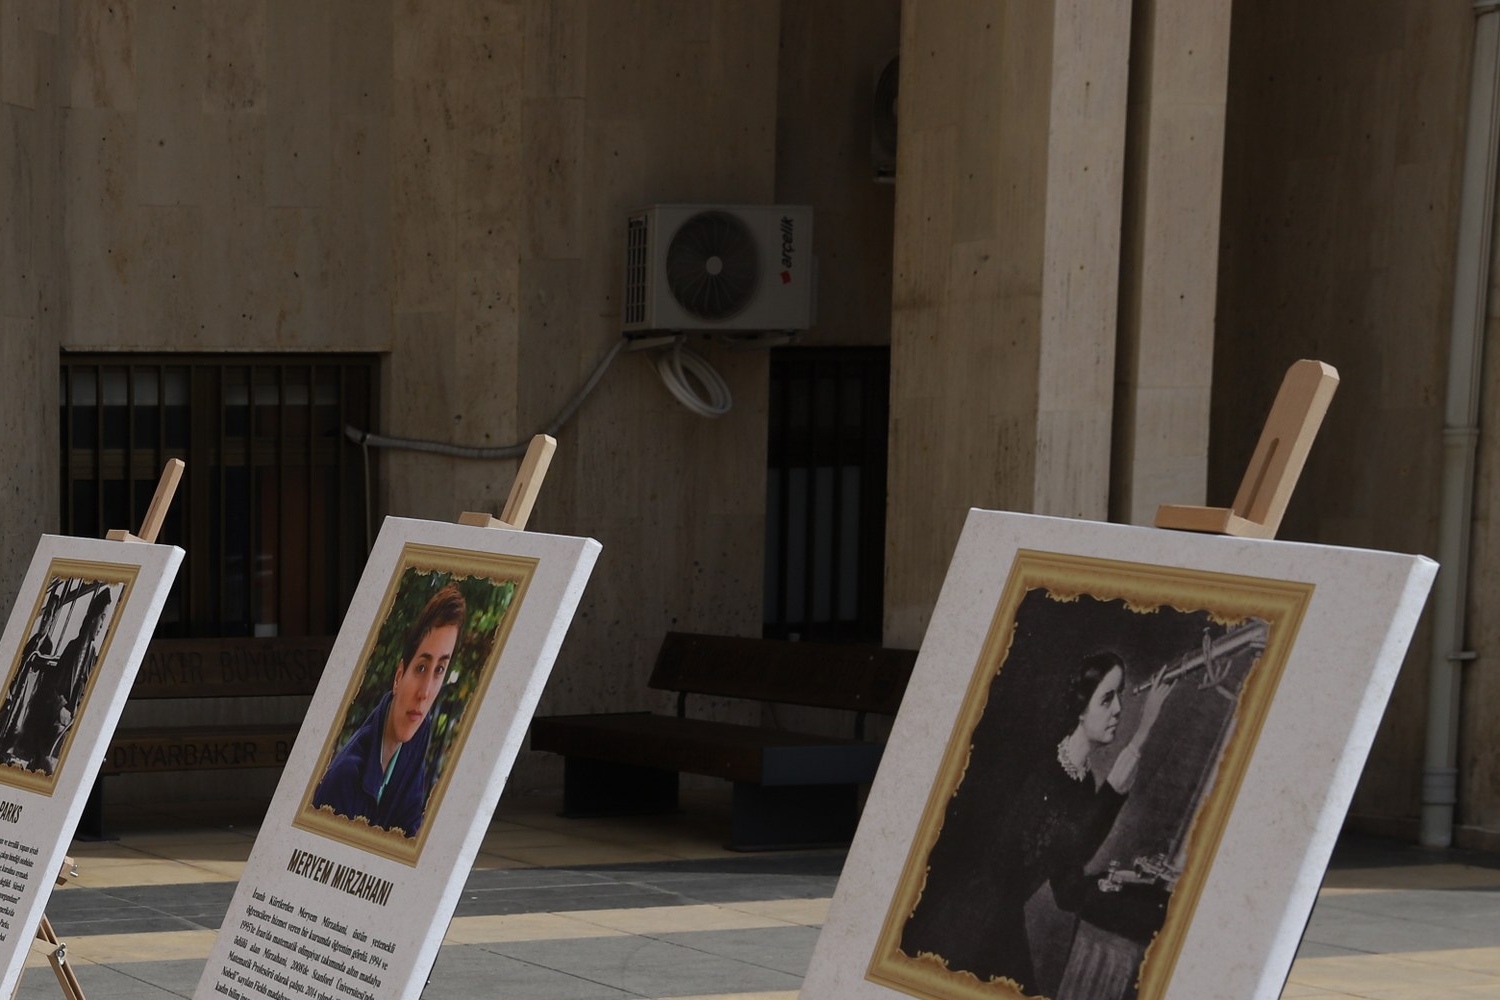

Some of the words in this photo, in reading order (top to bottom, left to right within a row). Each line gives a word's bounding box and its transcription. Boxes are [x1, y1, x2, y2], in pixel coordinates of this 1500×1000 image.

[780, 216, 796, 268] arçelik
[220, 645, 325, 685] BÜYÜKŞE
[287, 849, 335, 885] MERYEM
[331, 864, 394, 907] MIRZAHANI
